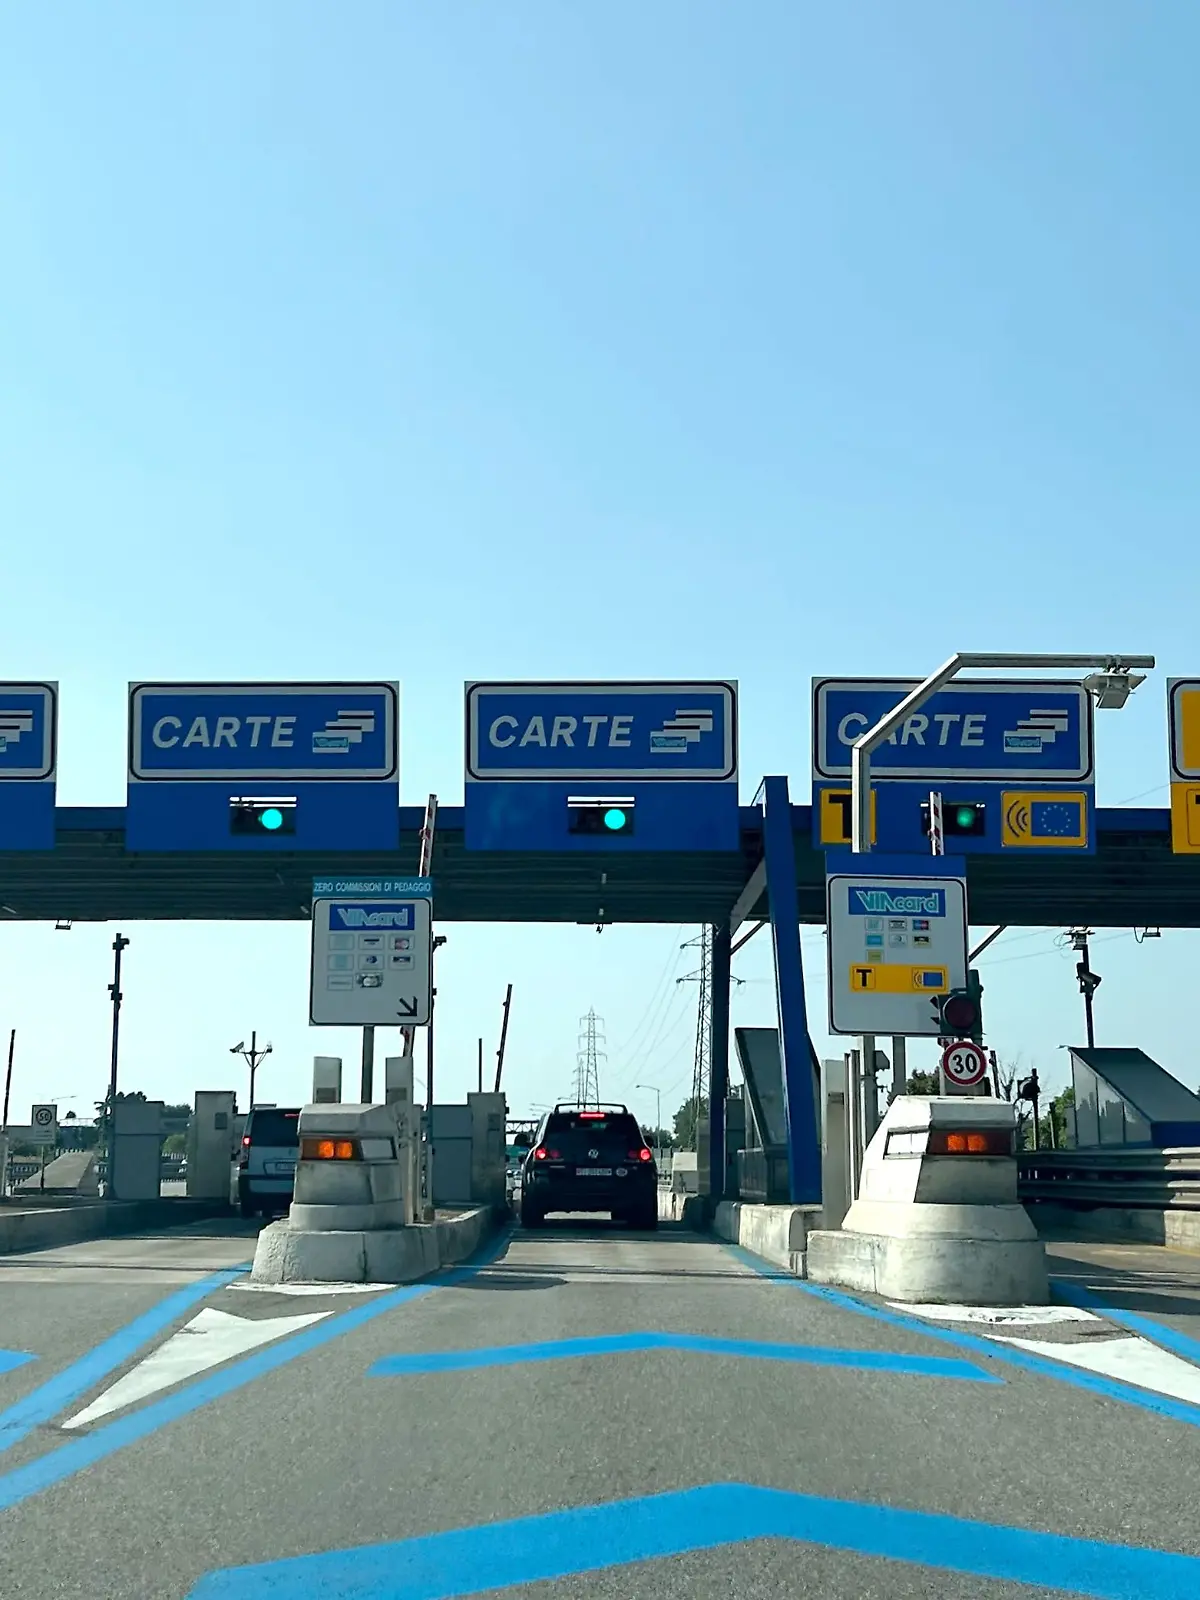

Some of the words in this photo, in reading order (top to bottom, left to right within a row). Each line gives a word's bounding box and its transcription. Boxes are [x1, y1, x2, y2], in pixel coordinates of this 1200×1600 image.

[152, 715, 297, 748] CARTE
[488, 714, 634, 748] CARTE
[314, 882, 334, 892] ZERO
[335, 882, 382, 892] COMMISSIONI
[384, 882, 392, 892] DI
[394, 882, 431, 892] PEDAGGIO
[855, 968, 873, 987] T
[952, 1053, 977, 1074] 30
